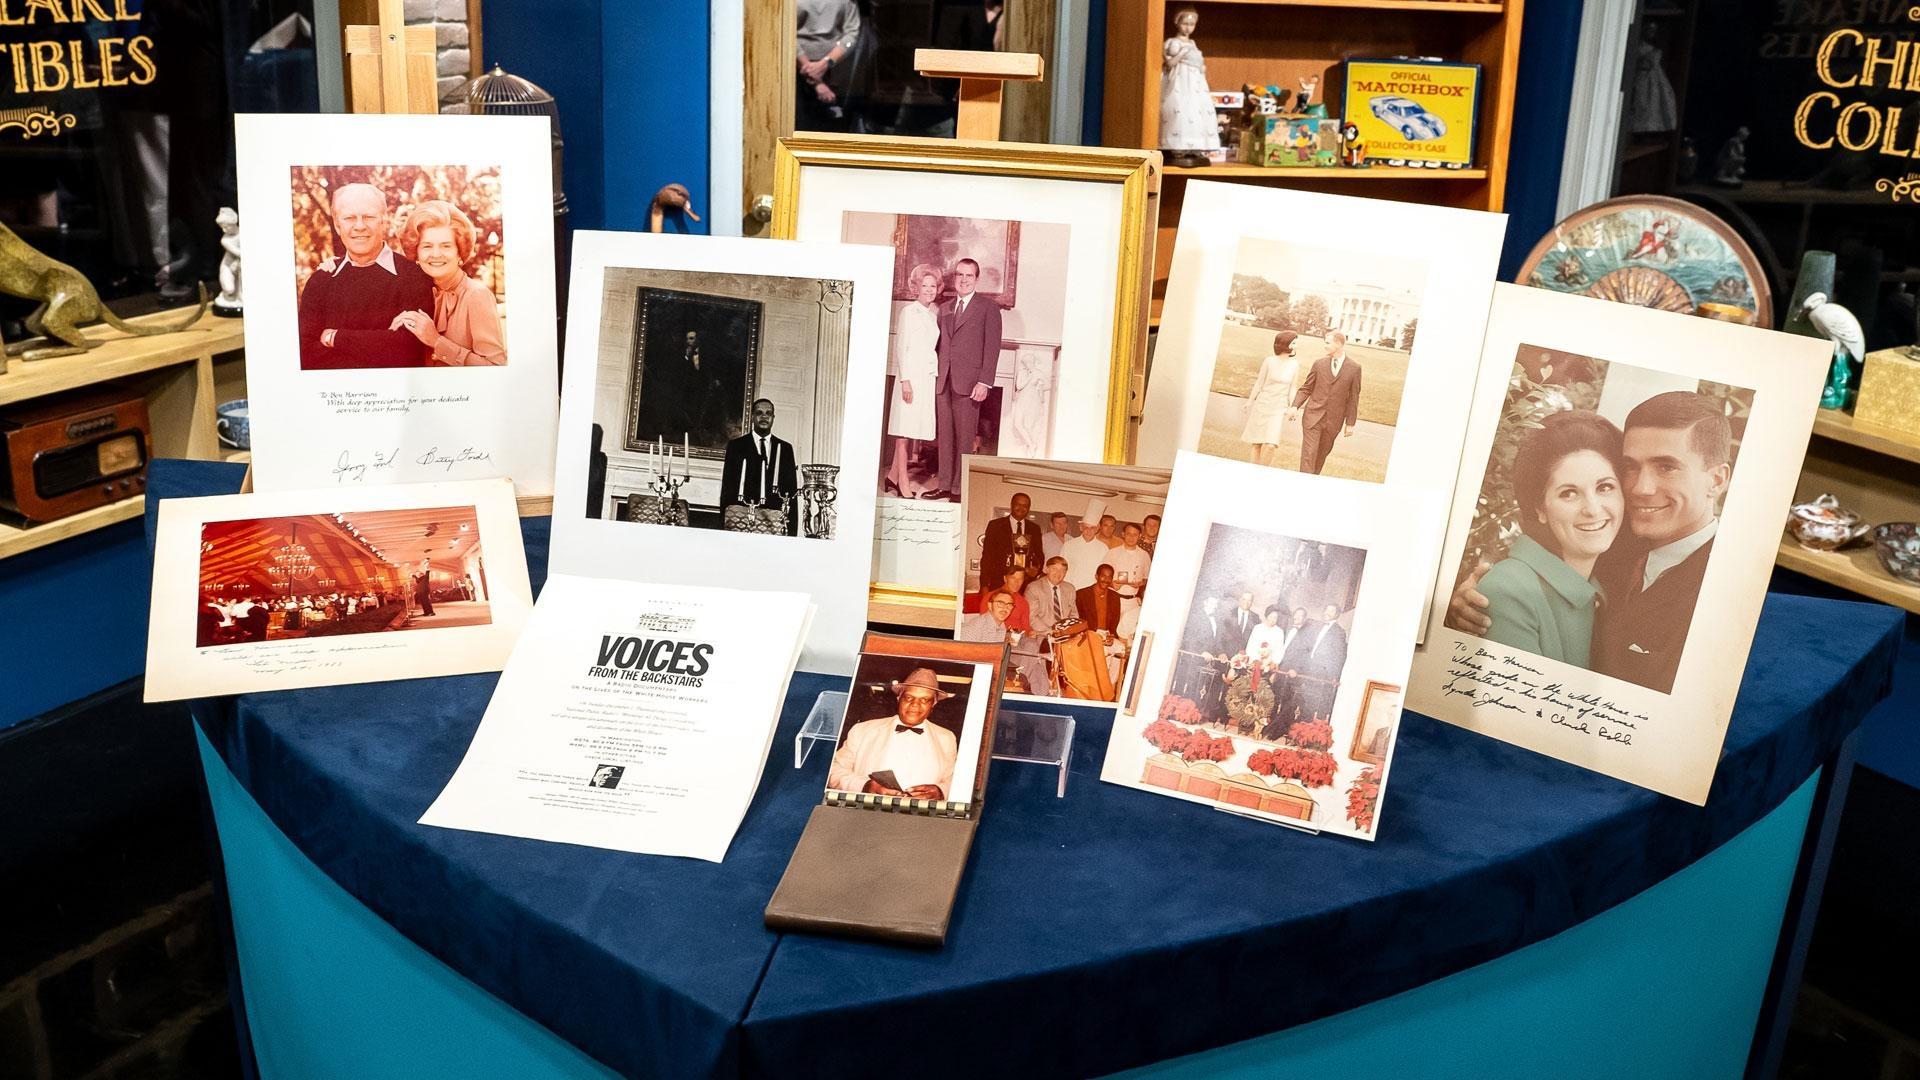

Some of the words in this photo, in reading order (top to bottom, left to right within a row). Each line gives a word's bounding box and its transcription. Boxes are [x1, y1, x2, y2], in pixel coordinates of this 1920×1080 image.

[0, 35, 157, 94] IBLES
[1390, 71, 1432, 82] OFFICIAL
[1794, 91, 1920, 159] COL
[1367, 140, 1423, 152] COLLECTOR'S
[1425, 143, 1448, 154] CASE
[438, 395, 470, 403] dedicated
[596, 634, 715, 678] VOICES
[1454, 641, 1468, 651] To
[1475, 647, 1497, 661] Ben
[588, 666, 619, 680] FROM
[620, 669, 641, 682] THE
[640, 671, 705, 689] BACKSTAIRS
[1447, 670, 1507, 687] reflected
[1577, 707, 1595, 720] of
[1472, 692, 1526, 714] Johnson
[1542, 683, 1563, 695] the
[1634, 711, 1649, 721] is
